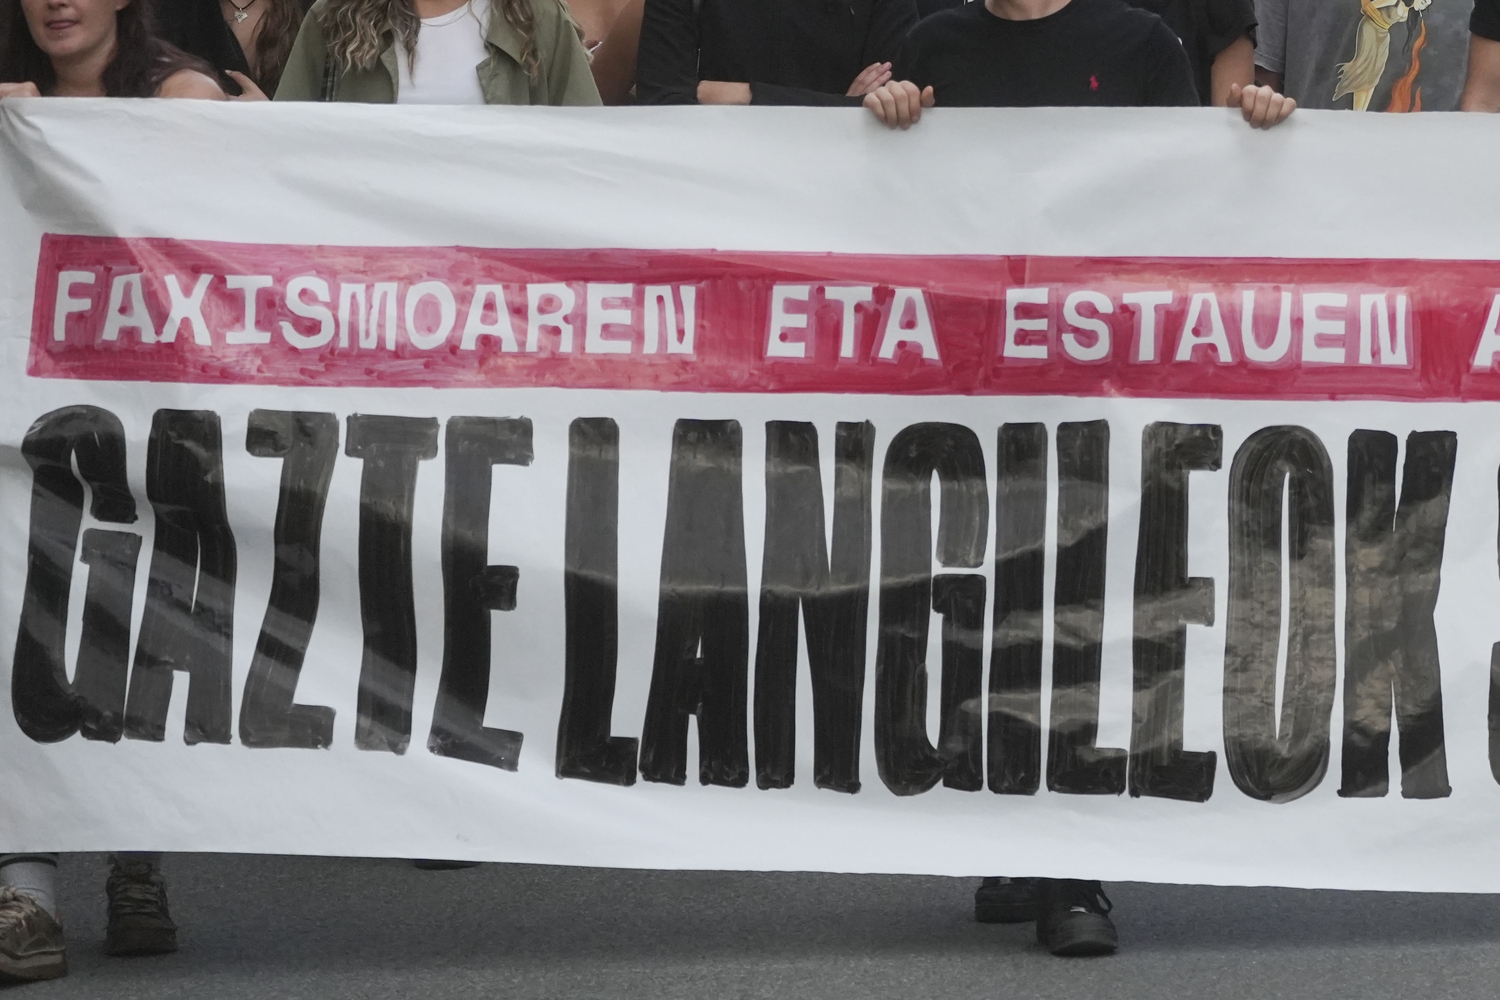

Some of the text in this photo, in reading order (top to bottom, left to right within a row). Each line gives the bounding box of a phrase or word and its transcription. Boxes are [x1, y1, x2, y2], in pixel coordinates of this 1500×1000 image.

[52, 269, 697, 355] FAXISMOAREN
[765, 284, 941, 362] ETA
[1003, 287, 1411, 366] ESTAUEN
[12, 404, 535, 772] GAZTE
[556, 416, 1458, 804] LANGILEOK
